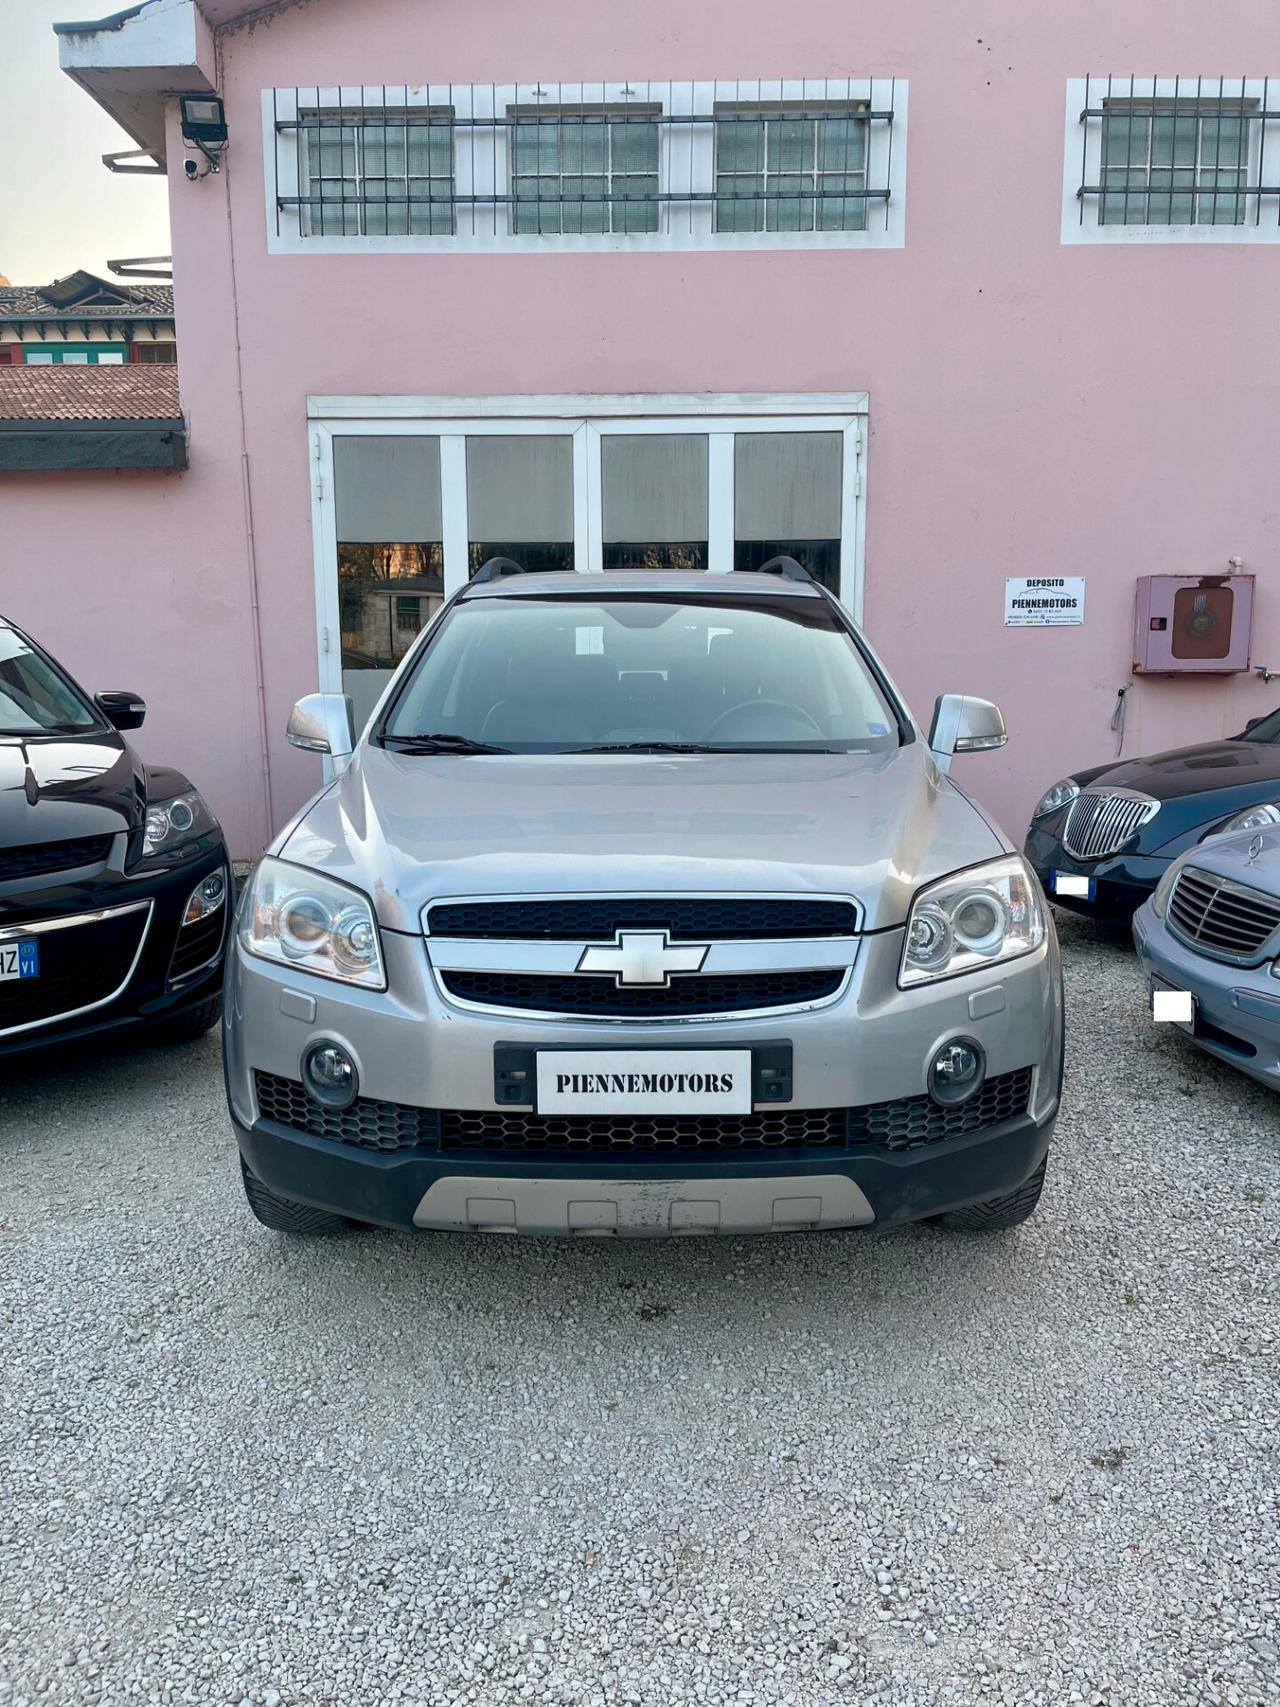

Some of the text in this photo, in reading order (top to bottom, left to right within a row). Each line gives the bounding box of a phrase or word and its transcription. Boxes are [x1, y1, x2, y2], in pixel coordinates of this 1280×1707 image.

[1026, 579, 1064, 587] DEPOSITO
[1012, 599, 1077, 608] PIENNEMOTORS
[21, 960, 34, 975] VI
[556, 1073, 733, 1093] PIENNEMOTORS
